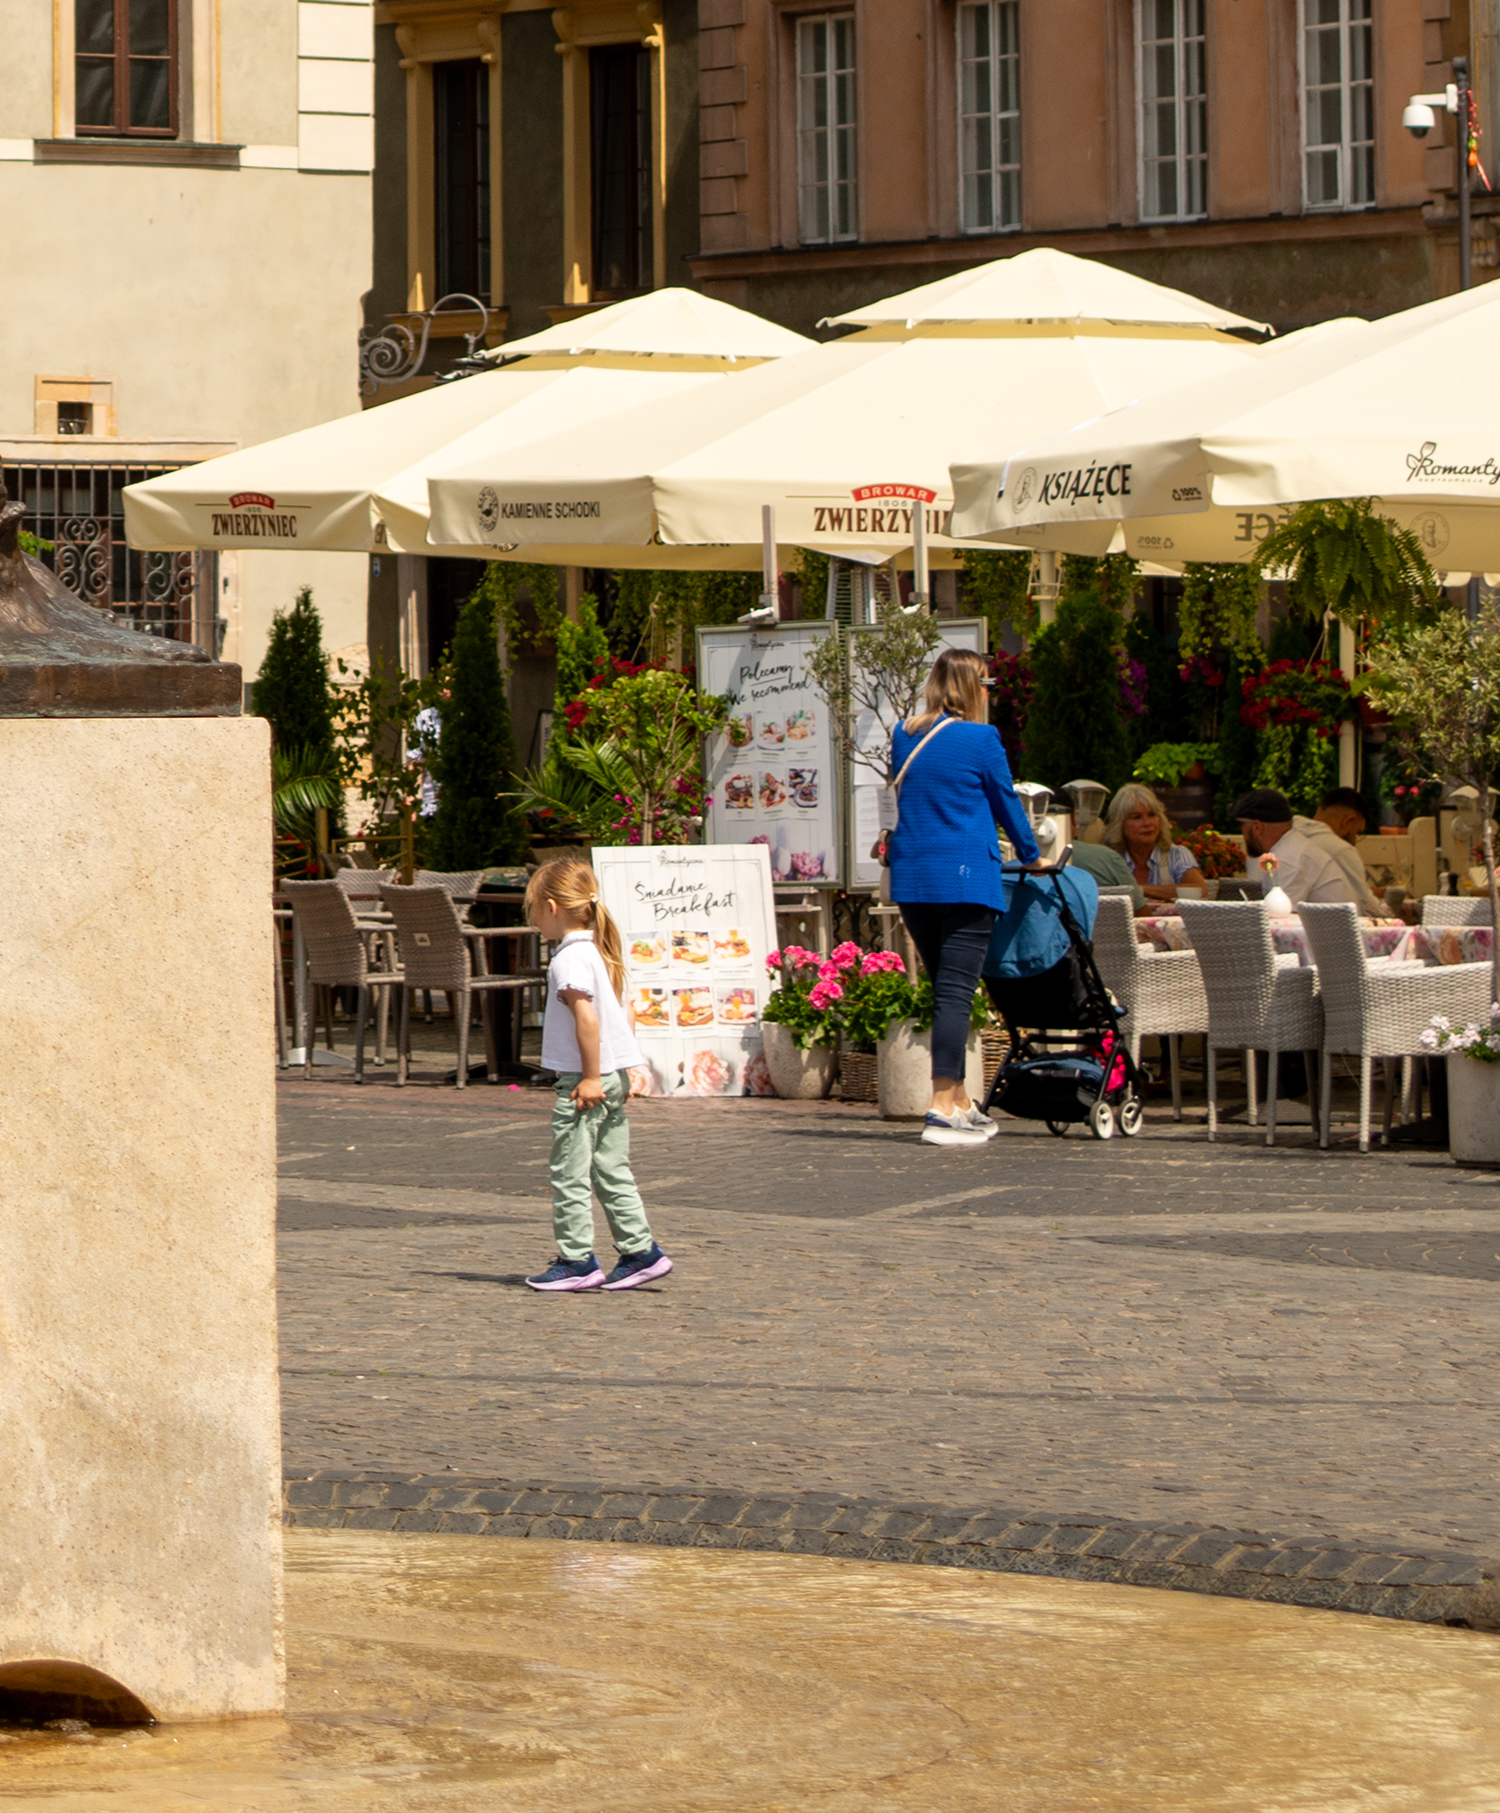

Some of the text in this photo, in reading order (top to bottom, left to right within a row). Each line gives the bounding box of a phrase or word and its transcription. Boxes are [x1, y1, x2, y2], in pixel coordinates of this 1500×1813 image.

[233, 492, 272, 506] BROWAR
[860, 485, 928, 500] BROWAR
[878, 499, 908, 507] 1806
[501, 501, 600, 519] KAMIENNE SCHODKI
[211, 513, 298, 538] ZWIERZYNIEC
[740, 661, 796, 684] Polecamy
[751, 674, 812, 702] recommend
[634, 877, 708, 902] Śniadanie
[652, 890, 737, 922] Breakfast
